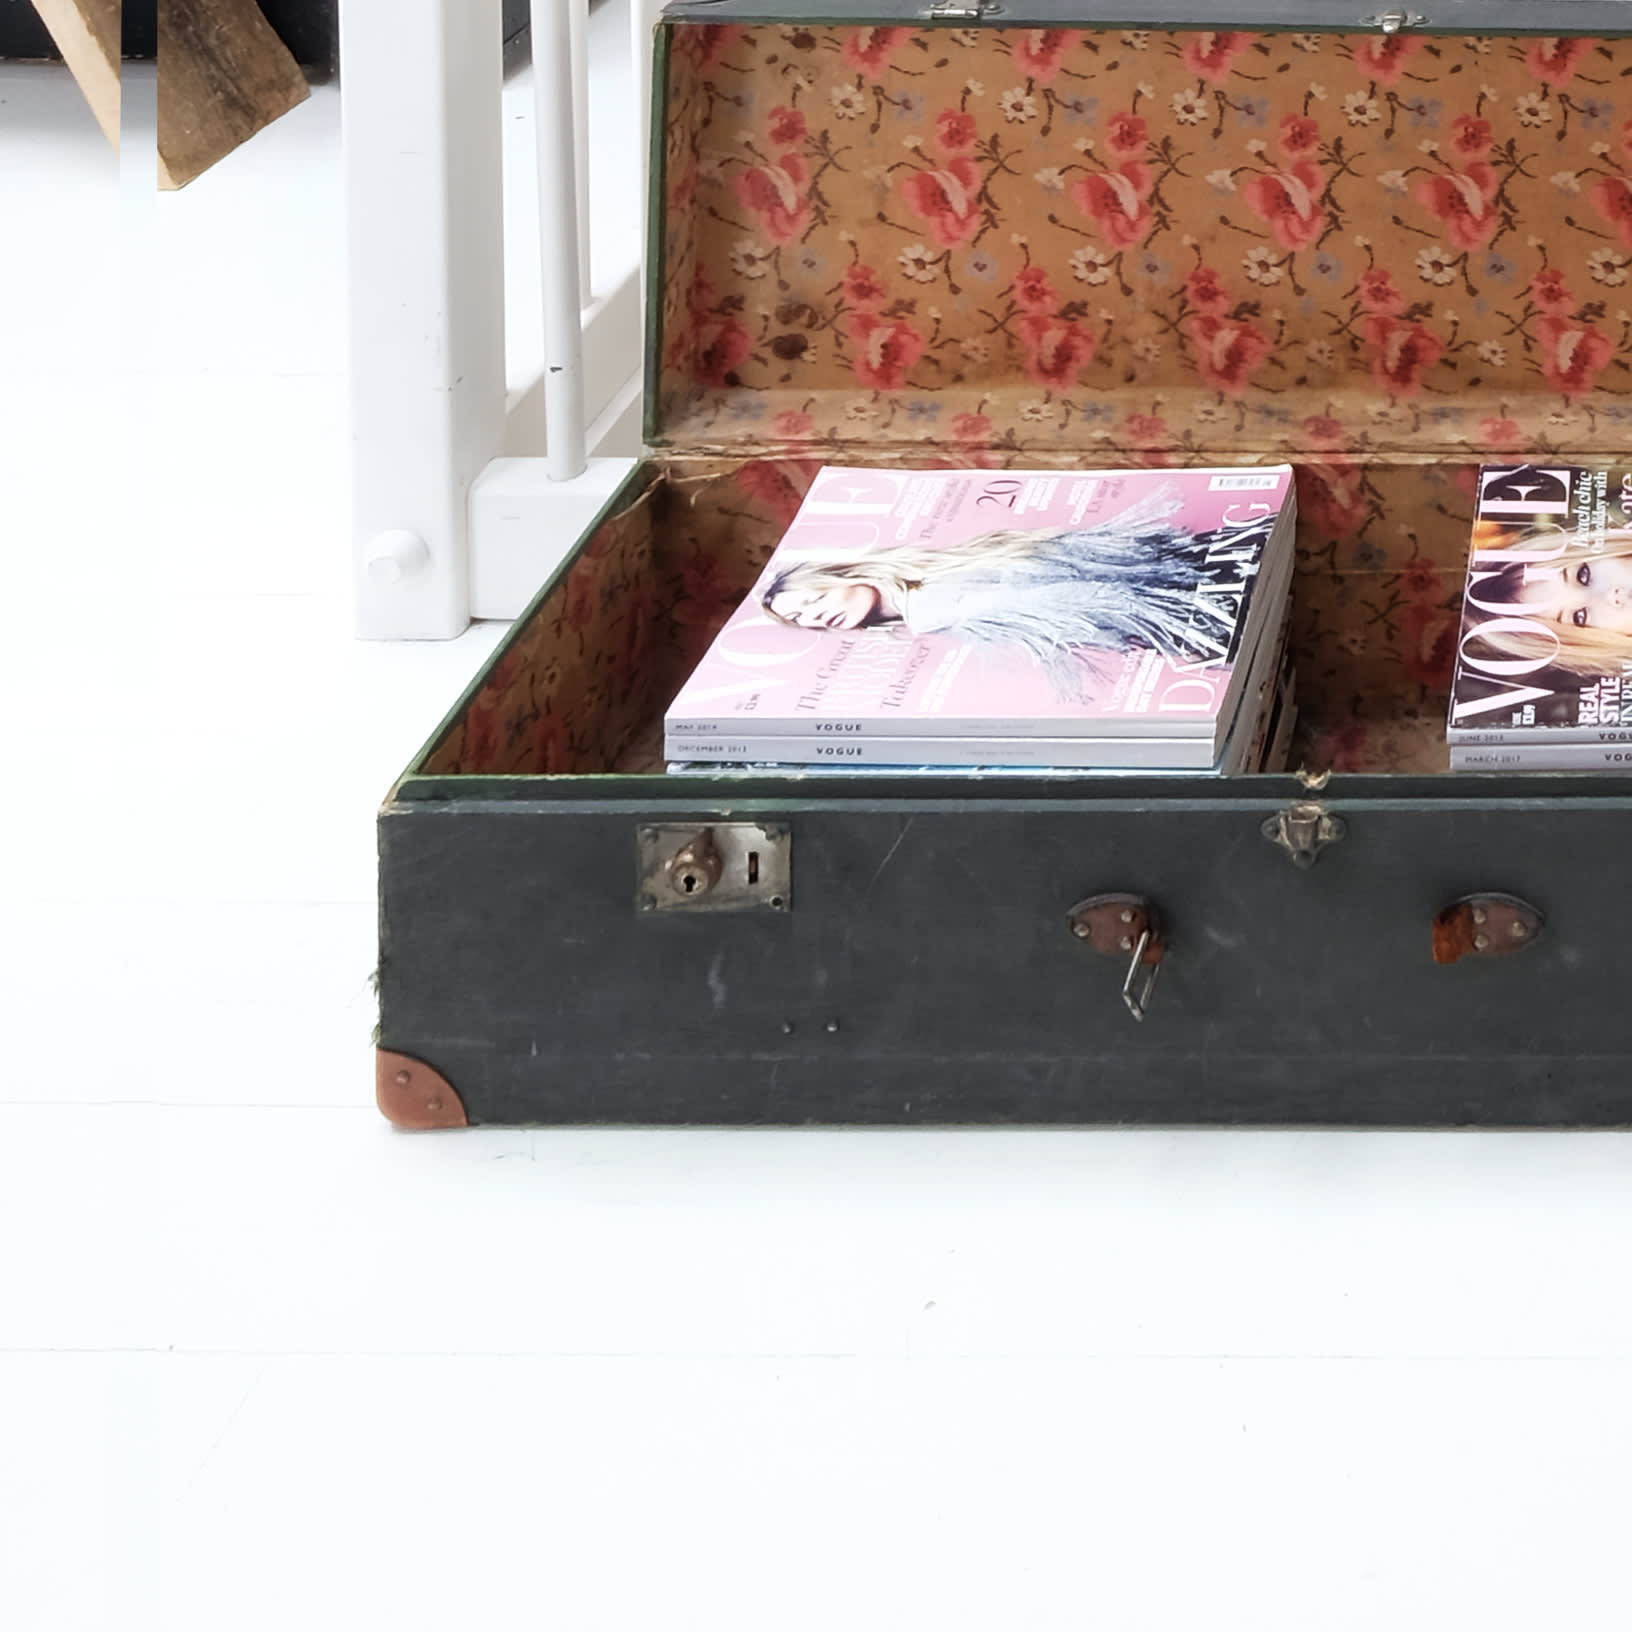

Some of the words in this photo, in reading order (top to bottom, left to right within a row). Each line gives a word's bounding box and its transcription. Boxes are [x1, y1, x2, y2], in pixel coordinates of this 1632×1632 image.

[976, 479, 1024, 509] 20
[1574, 470, 1594, 503] chic
[1593, 470, 1608, 496] with
[1571, 504, 1592, 546] Beach
[681, 472, 901, 705] VOUE
[1453, 469, 1572, 719] VOGUE
[795, 683, 827, 711] The
[1577, 683, 1599, 723] REAL
[1598, 676, 1620, 724] STYLE
[815, 723, 863, 732] VOGUE
[816, 747, 864, 756] VOGUE
